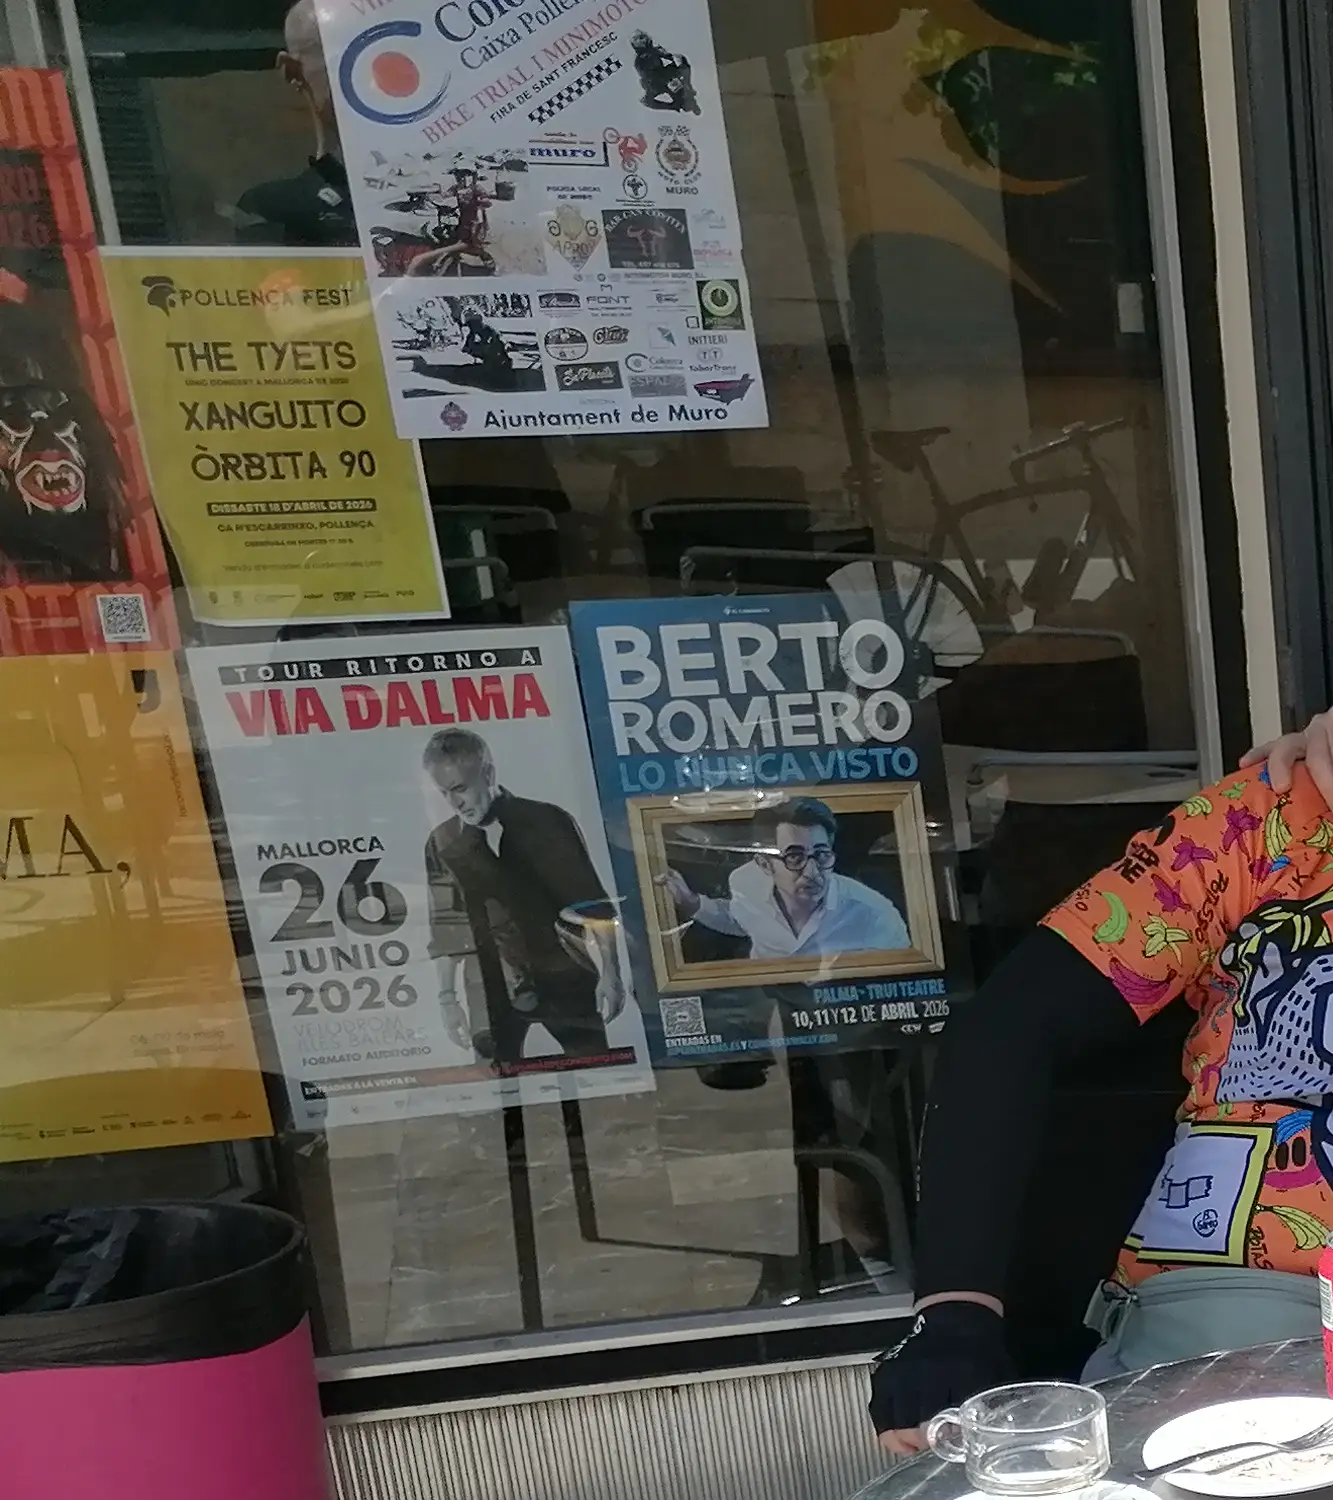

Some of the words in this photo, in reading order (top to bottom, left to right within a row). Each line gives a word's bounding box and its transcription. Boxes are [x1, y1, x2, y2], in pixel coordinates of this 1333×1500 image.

[460, 27, 522, 70] Caixa
[489, 102, 517, 124] FIRA
[515, 90, 533, 106] DE
[532, 68, 560, 93] SANT
[560, 31, 618, 73] FRANCESC
[422, 102, 475, 144] BIKE
[470, 64, 534, 110] TRIAL
[303, 288, 352, 307] FEST
[165, 341, 238, 373] THE
[246, 340, 357, 372] TYETS
[179, 399, 367, 431] XANGUITO
[483, 408, 621, 430] Ajuntament
[630, 403, 659, 424] de
[668, 403, 729, 422] Muro
[190, 444, 328, 481] ÒRBITA
[339, 449, 377, 478] 90
[328, 501, 344, 510] DE
[346, 500, 374, 510] 2026
[234, 662, 325, 684] TOUR
[345, 651, 498, 677] RITORNO
[520, 648, 537, 666] A
[596, 618, 906, 700] BERTO
[225, 686, 337, 738] VIA
[340, 672, 551, 731] DALMA
[608, 690, 913, 756] ROMERO
[620, 760, 667, 793] LO
[674, 754, 807, 788] NUNCA
[809, 746, 920, 781] VISTO
[257, 835, 386, 862] MALLORCA
[259, 857, 408, 943] 26
[280, 939, 410, 977] JUNIO
[286, 974, 419, 1017] 2026
[900, 978, 946, 998] TEATRE
[861, 1004, 878, 1023] DE
[881, 1001, 920, 1021] ABRIL
[922, 1000, 950, 1018] 2026
[302, 1052, 362, 1067] FORMATO
